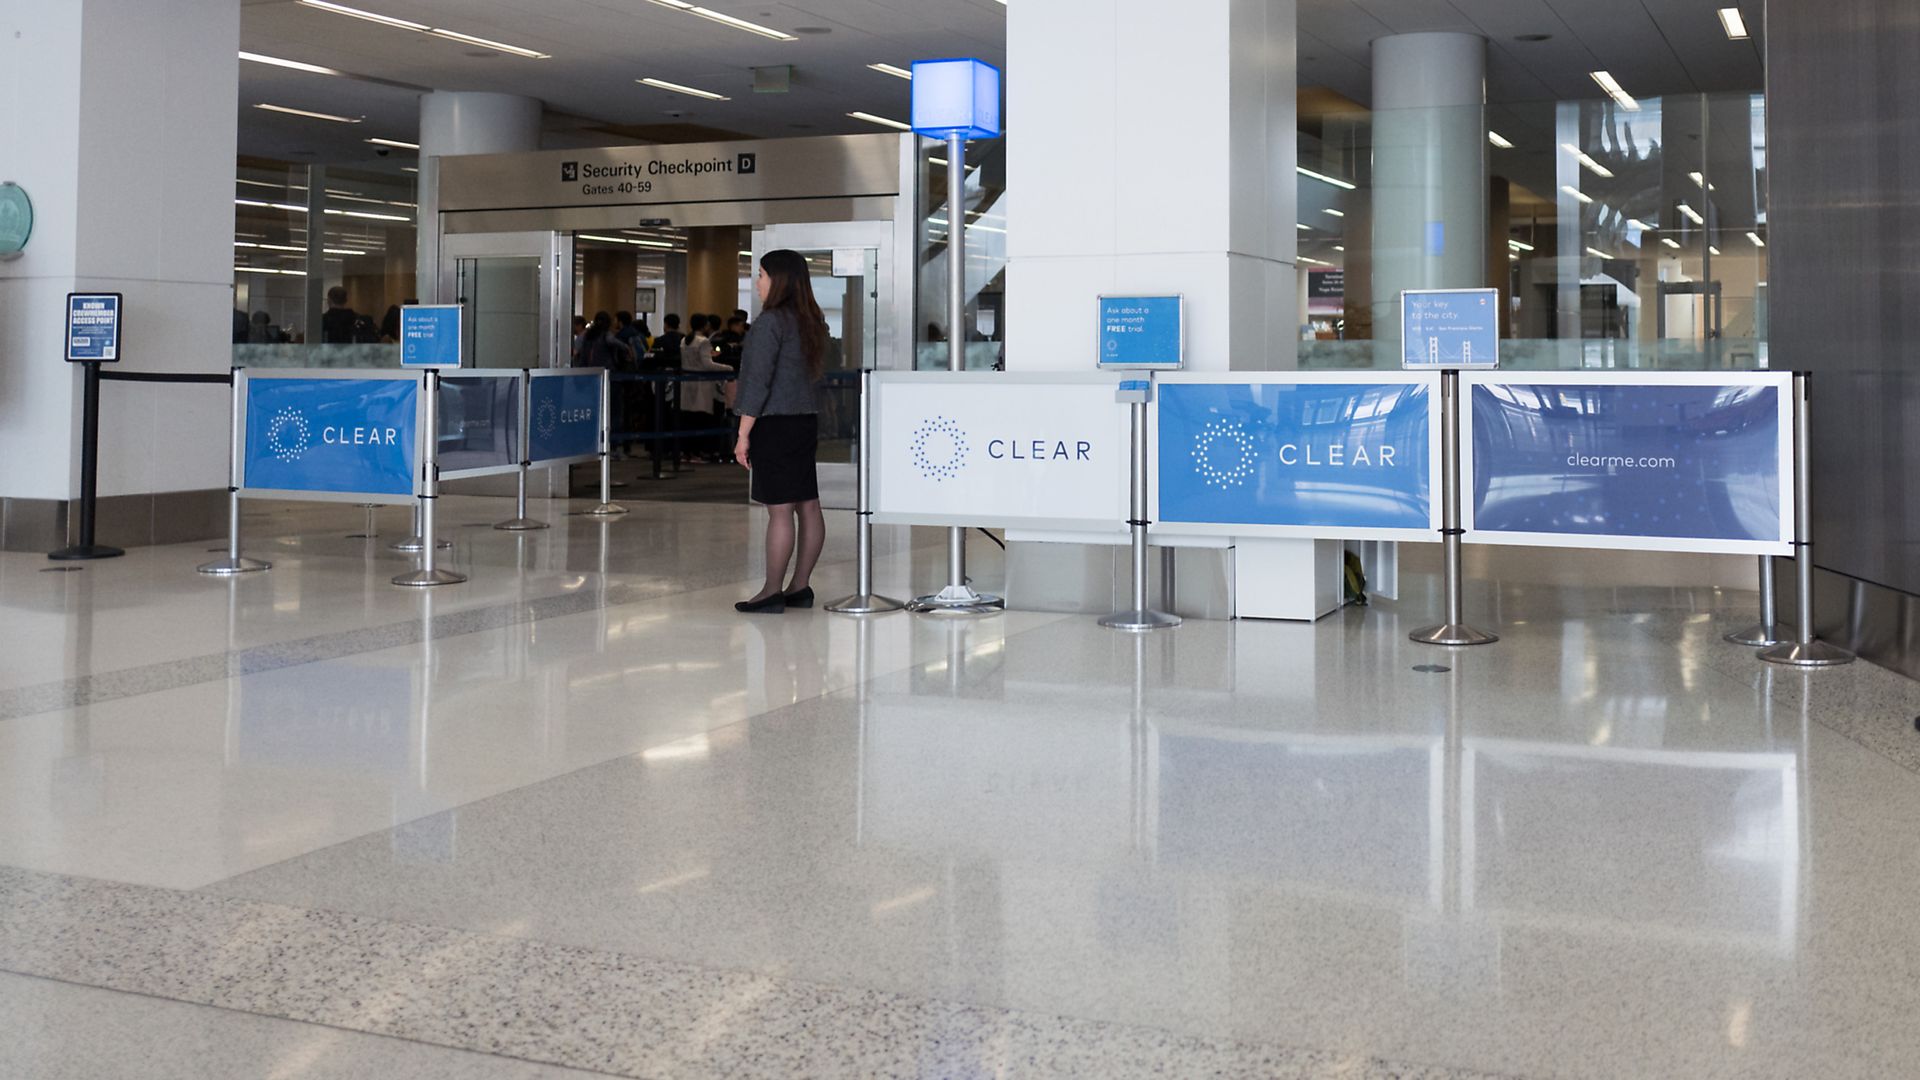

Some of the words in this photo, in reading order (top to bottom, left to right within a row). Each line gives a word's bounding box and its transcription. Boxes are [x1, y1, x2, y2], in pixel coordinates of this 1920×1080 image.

[582, 161, 642, 179] Security
[647, 157, 733, 176] Checkpoint
[582, 183, 614, 195] Gates
[617, 181, 652, 193] 40-59
[1106, 306, 1119, 314] Ask
[1121, 306, 1142, 314] about
[1434, 300, 1448, 310] key
[560, 408, 592, 423] CLEAR
[323, 427, 396, 445] CLEAR
[988, 439, 1091, 461] CLEAR
[1279, 443, 1396, 466] CLEAR
[1567, 452, 1675, 468] clearme.com
